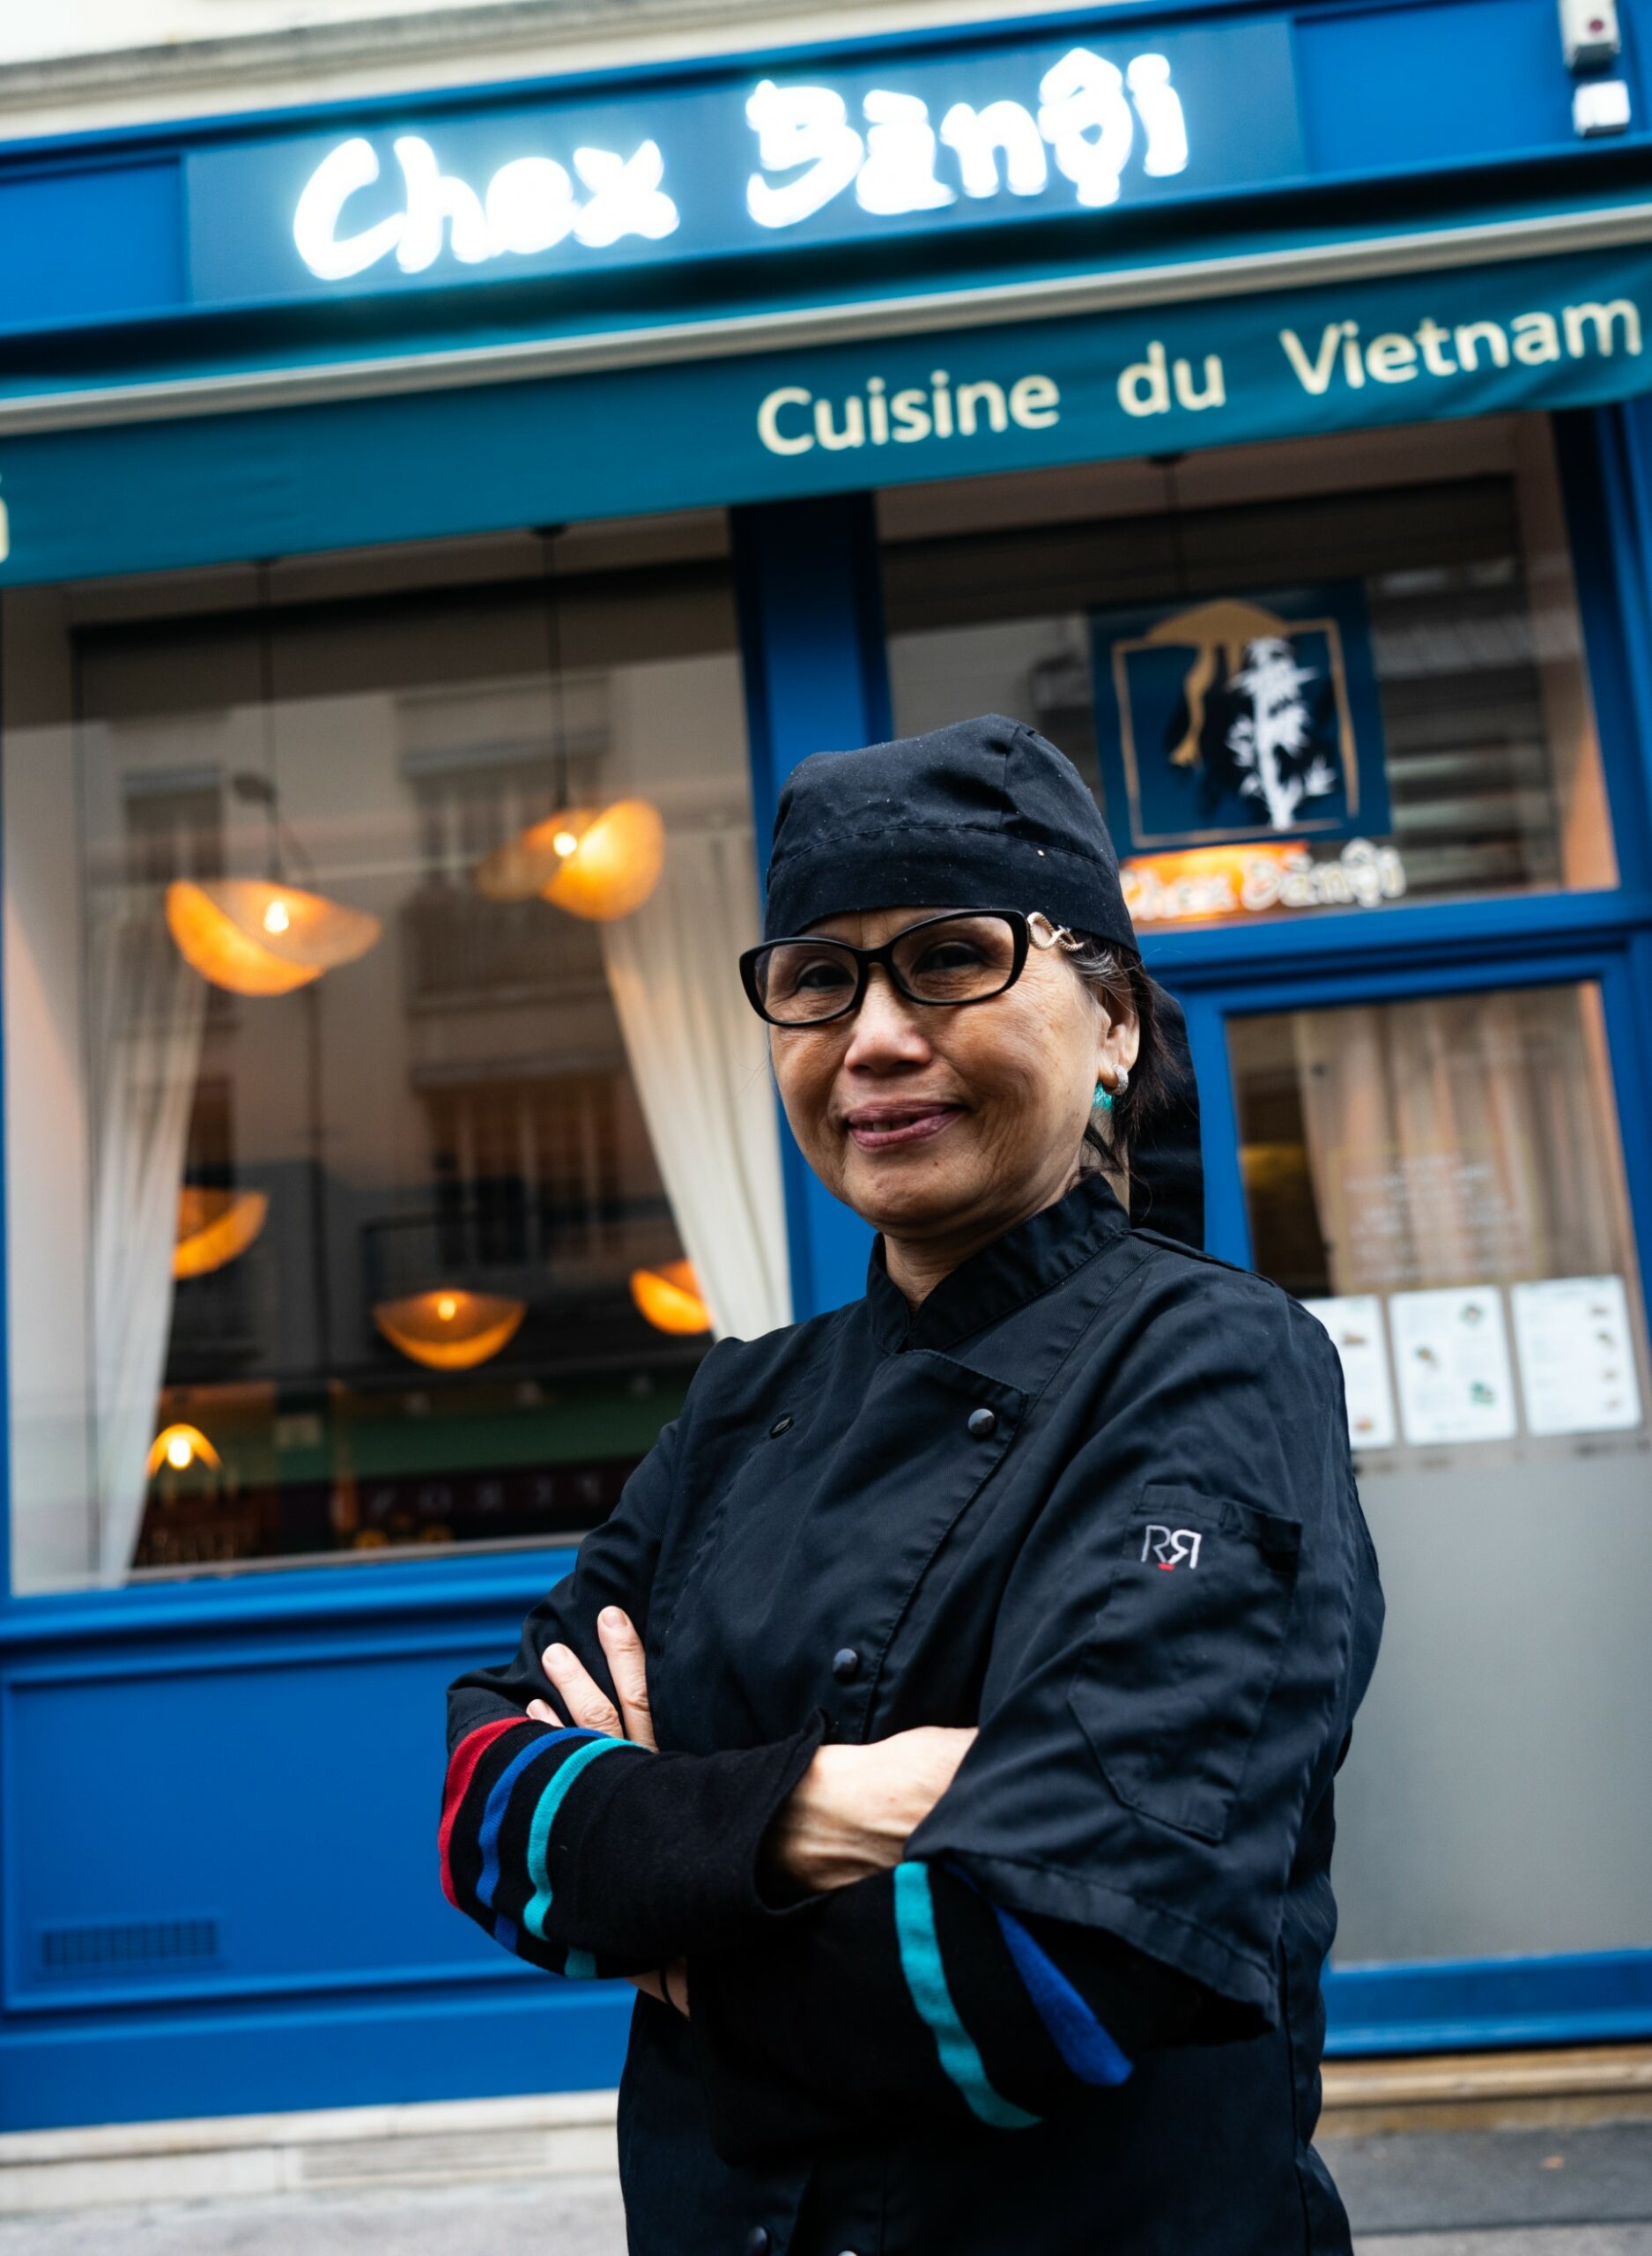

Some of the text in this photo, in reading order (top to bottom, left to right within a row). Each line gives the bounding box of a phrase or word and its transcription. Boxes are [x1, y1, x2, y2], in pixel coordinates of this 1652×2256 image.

[758, 299, 1641, 456] Cuisine du Vietnam
